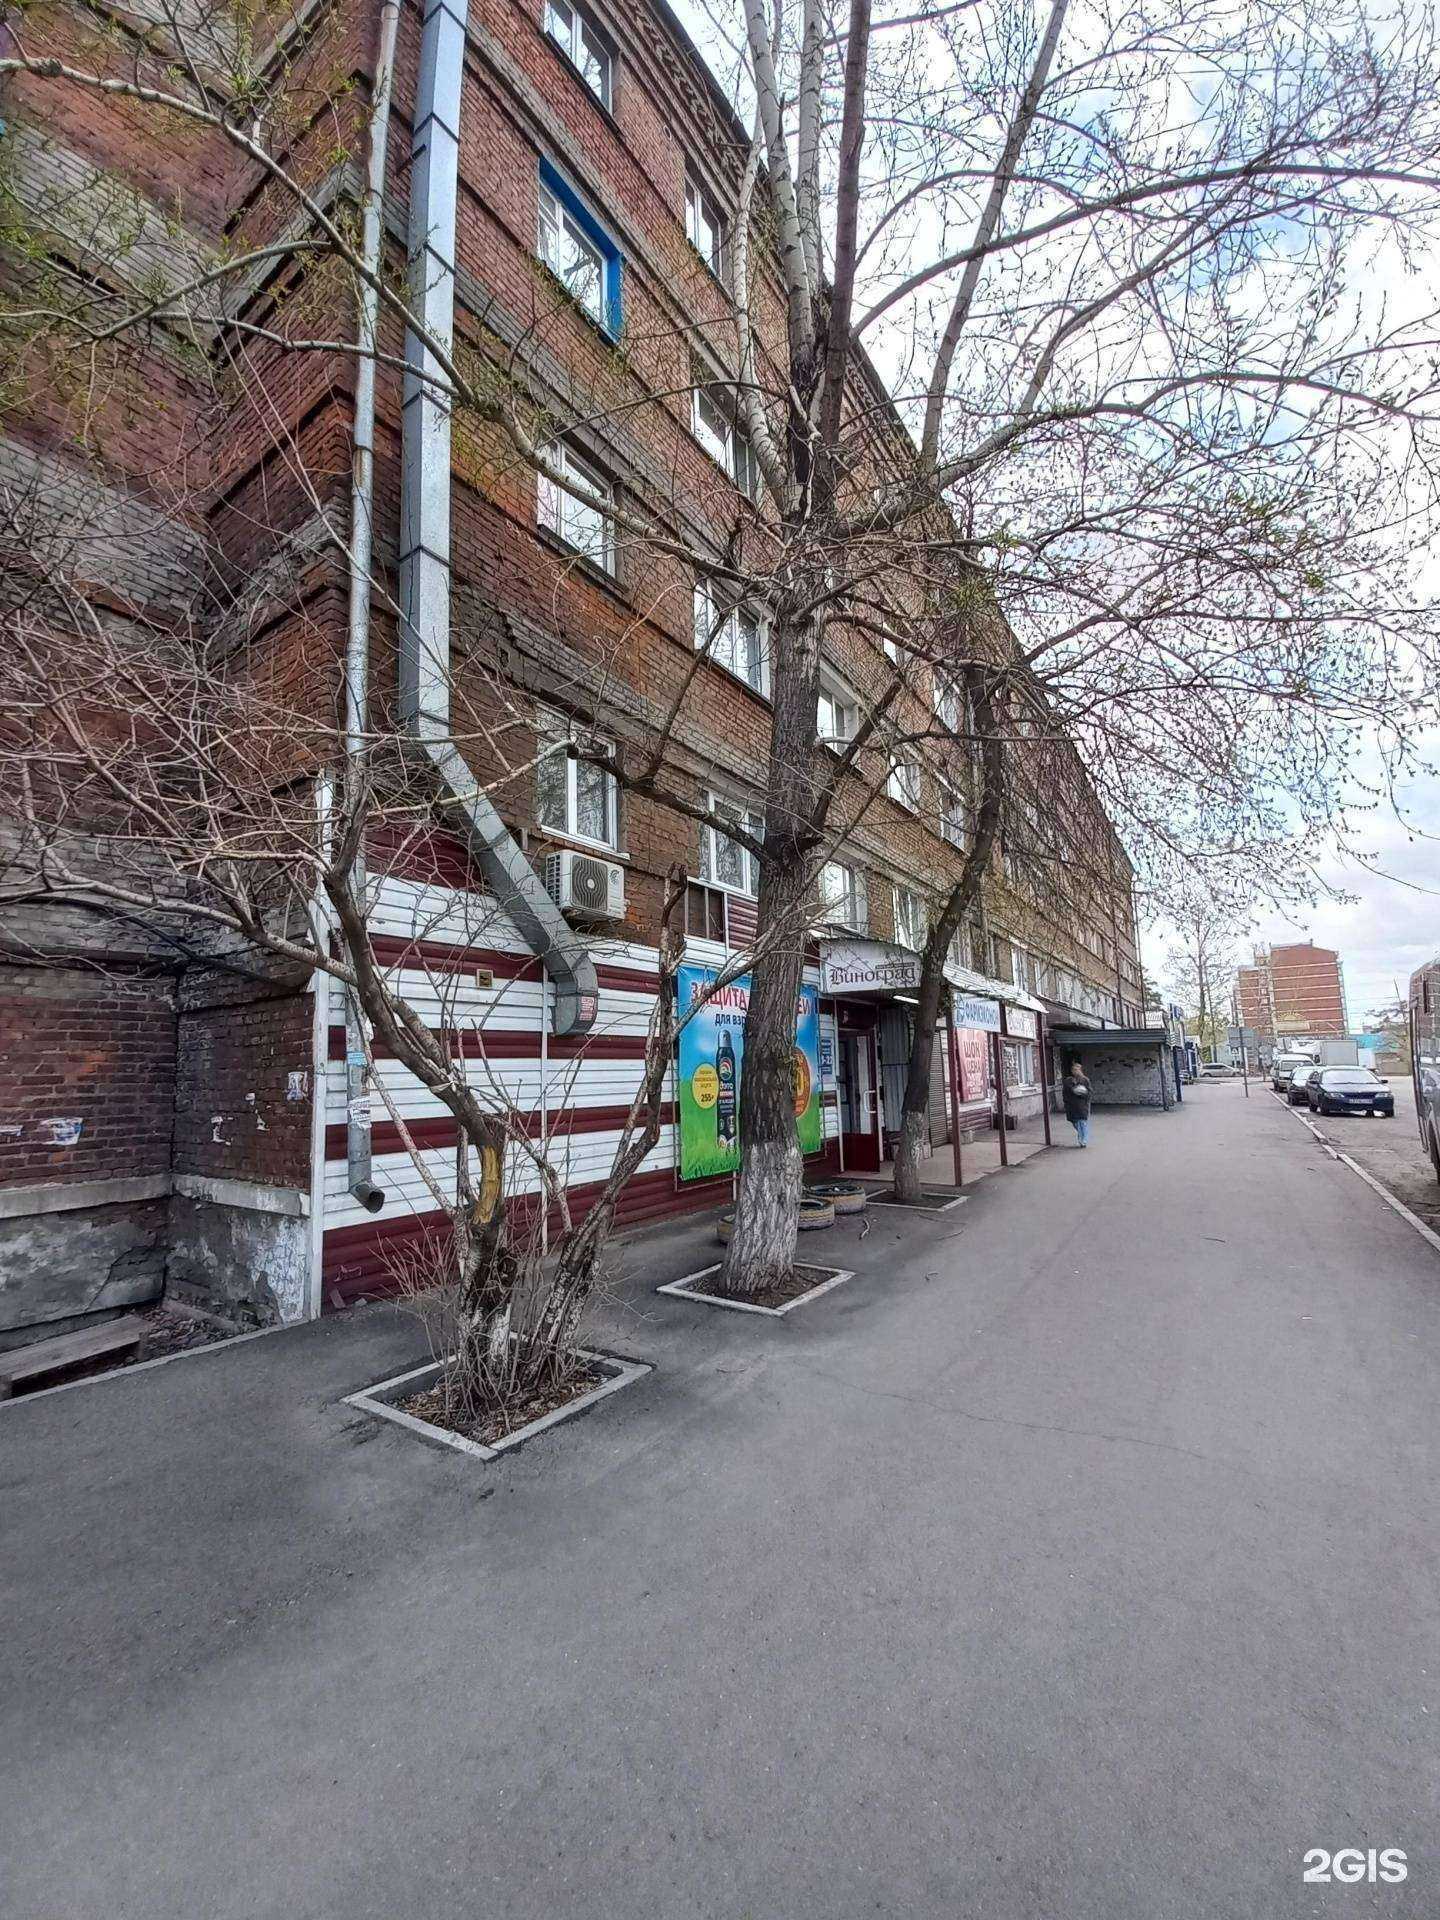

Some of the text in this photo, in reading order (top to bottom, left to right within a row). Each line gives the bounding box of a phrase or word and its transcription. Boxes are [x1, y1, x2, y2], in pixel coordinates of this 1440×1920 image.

[829, 967, 916, 985] Виноград
[715, 1013, 747, 1028] ДЛЯ ВЗР
